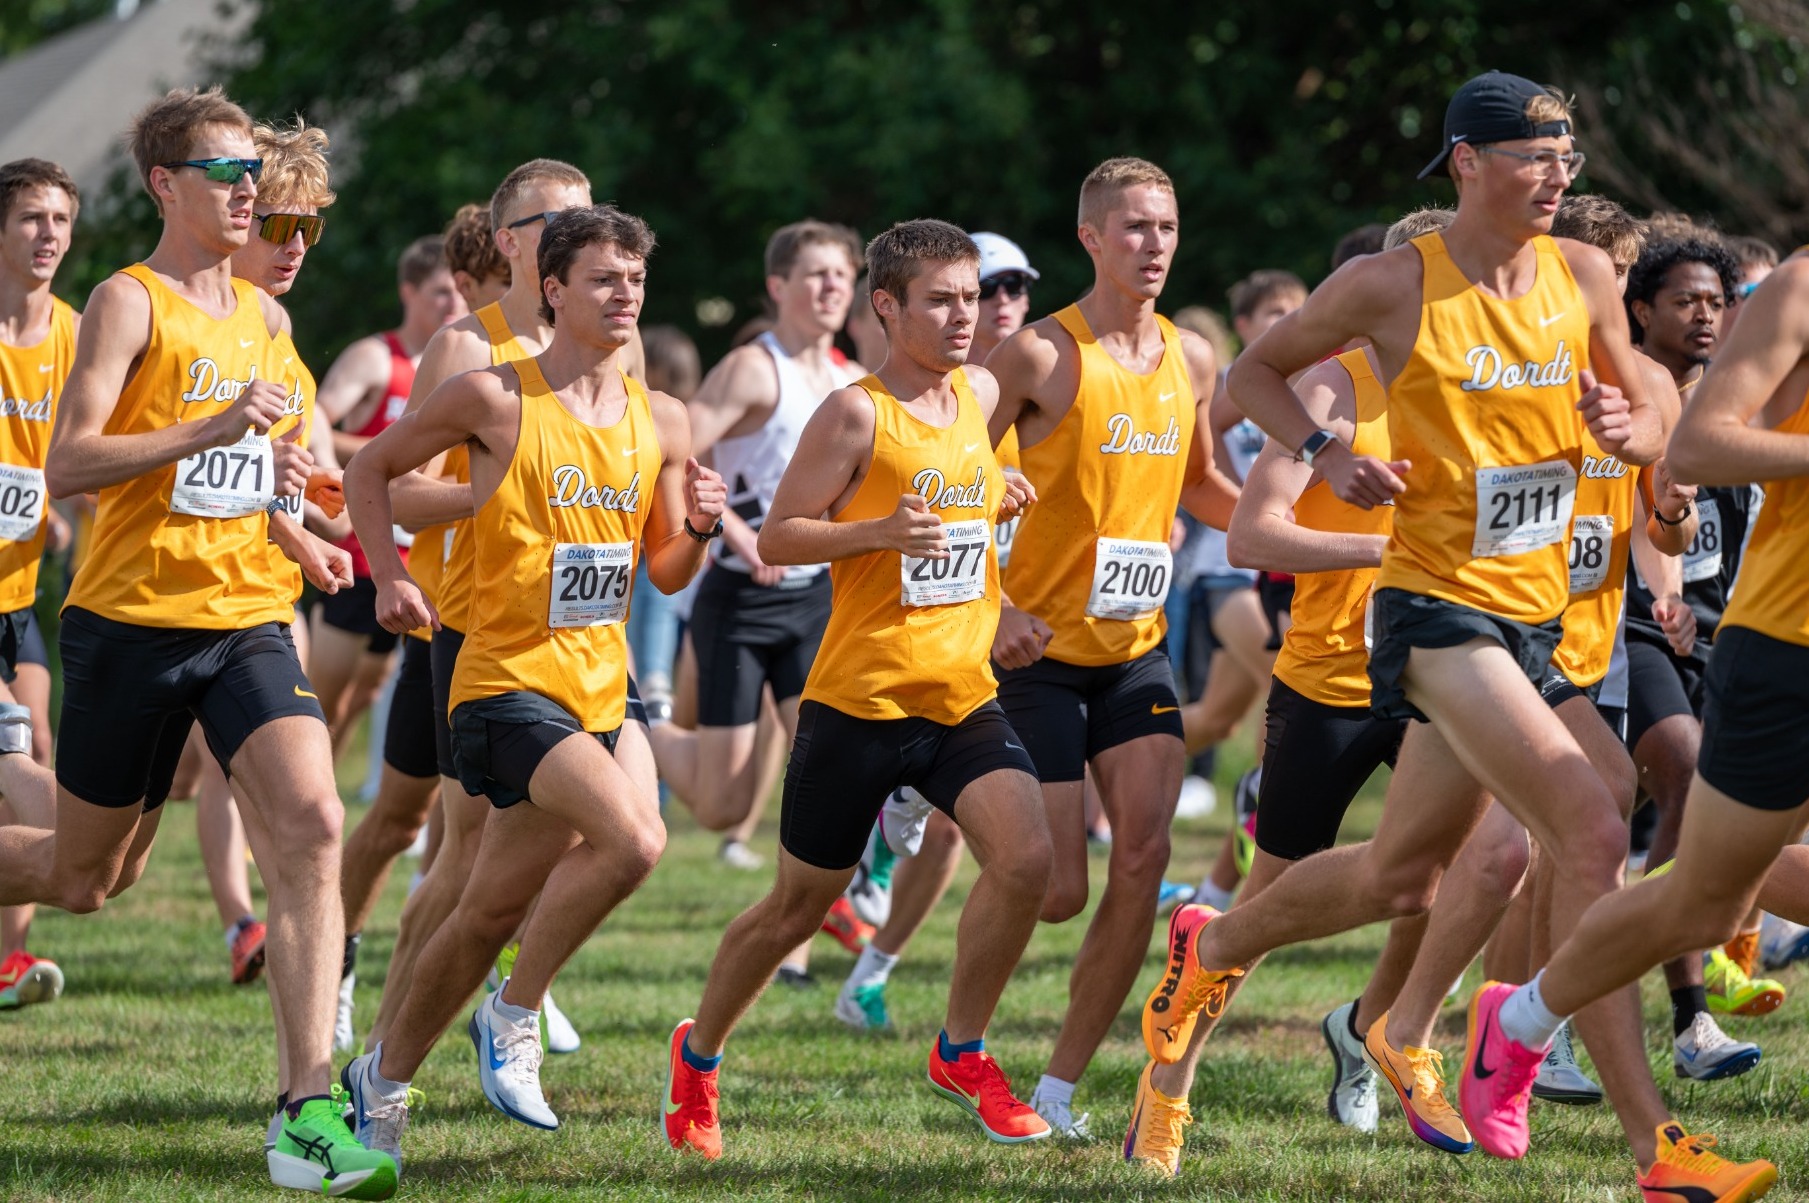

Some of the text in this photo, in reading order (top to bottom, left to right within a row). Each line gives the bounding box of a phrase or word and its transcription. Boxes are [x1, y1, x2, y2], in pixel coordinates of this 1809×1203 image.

[1461, 340, 1572, 391] Dordt
[1100, 413, 1180, 456] Dordt
[184, 450, 264, 493] 2071
[1491, 466, 1567, 486] DAKOTATIMING
[0, 485, 39, 519] 02
[1489, 484, 1561, 530] 2111
[567, 547, 632, 560] DAKOTATIMING
[910, 541, 986, 582] 2077
[1109, 544, 1167, 558] DAKOTATIMING
[1568, 535, 1603, 569] 08
[559, 564, 629, 601] 2075
[1099, 560, 1166, 598] 2100
[1151, 925, 1191, 1013] NITRO
